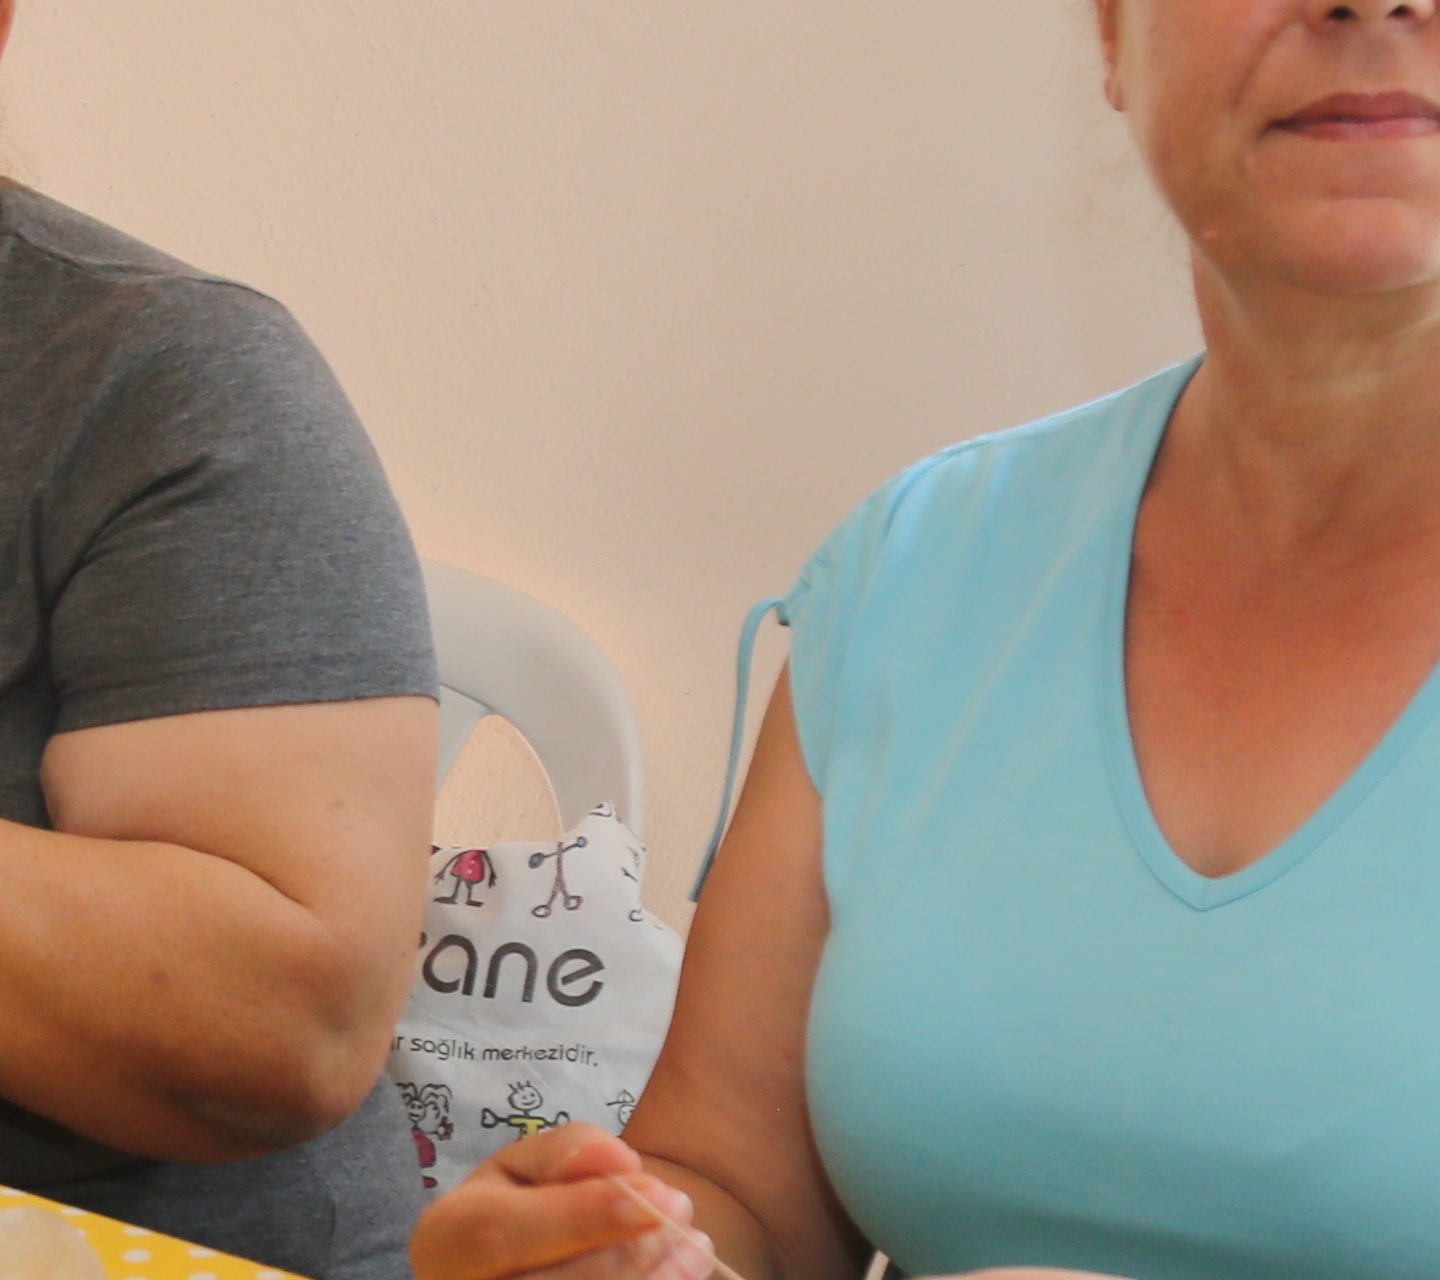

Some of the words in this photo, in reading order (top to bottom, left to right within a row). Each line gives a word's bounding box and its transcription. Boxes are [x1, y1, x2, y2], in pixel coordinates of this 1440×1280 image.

[419, 932, 605, 1007] ane
[411, 1037, 475, 1061] sağlık
[482, 1044, 599, 1067] merkezidir.
